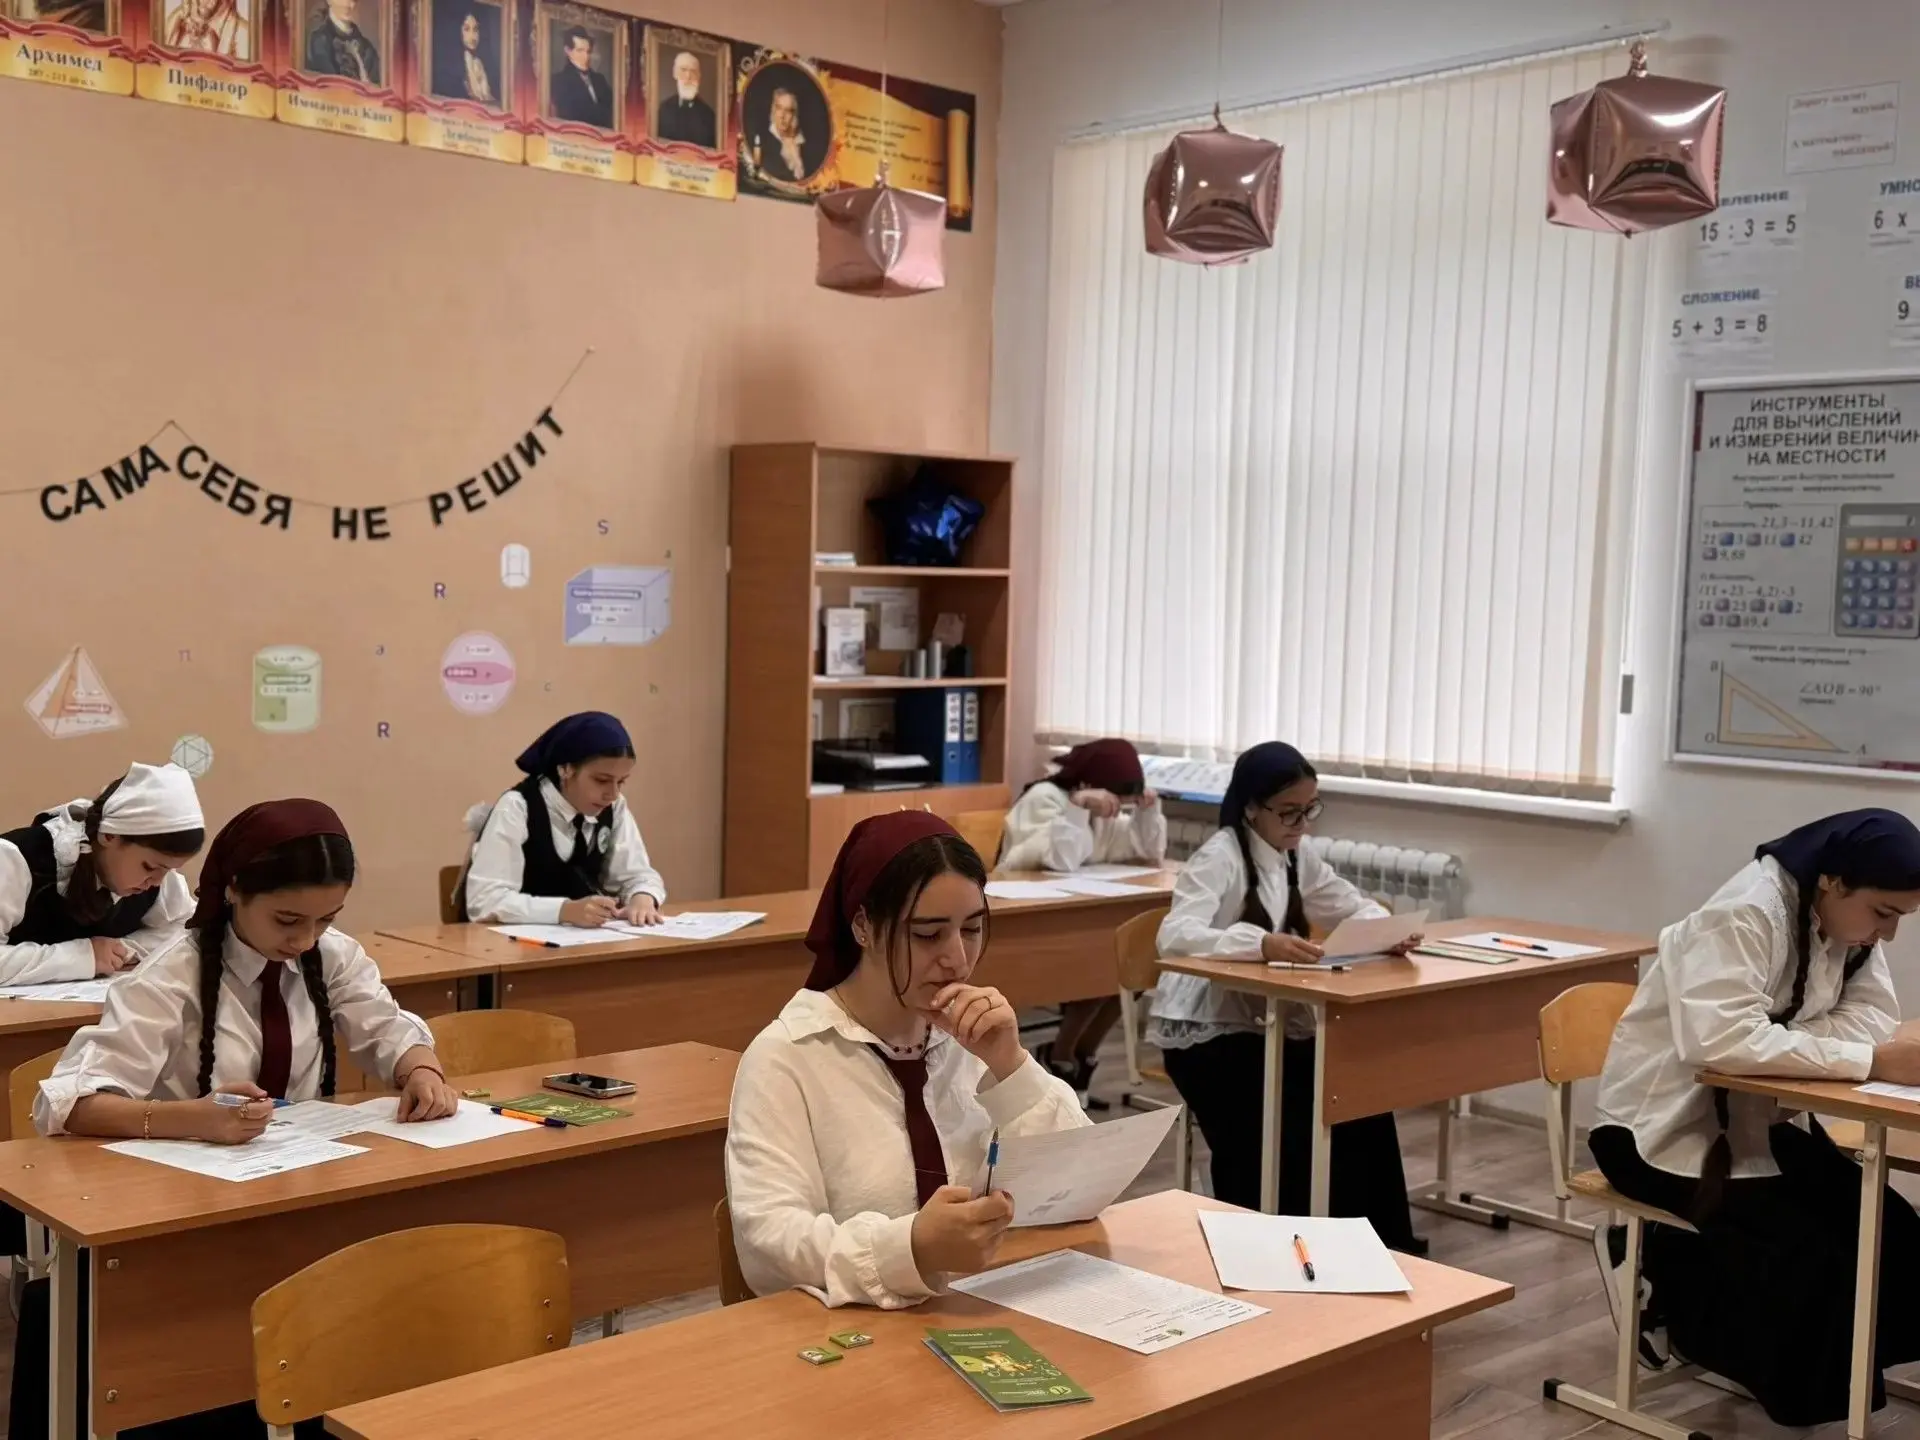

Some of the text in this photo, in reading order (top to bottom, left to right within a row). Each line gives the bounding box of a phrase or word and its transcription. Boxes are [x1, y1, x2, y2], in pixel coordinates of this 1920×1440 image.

[16, 44, 103, 72] Архимед
[168, 68, 248, 100] Пифагор
[1721, 190, 1790, 208] ЕЛЕНИЕ
[1700, 221, 1719, 242] 15
[1744, 218, 1755, 238] 3
[1765, 220, 1776, 231] =
[1786, 214, 1797, 234] 5
[1874, 210, 1884, 230] 6
[1681, 288, 1761, 306] СЛОЖЕНИЕ
[1898, 300, 1909, 320] 9
[1672, 313, 1768, 338] 5 + 3 = 8
[1750, 393, 1886, 412] ИНСТРУМЕНТЫ
[1732, 407, 1902, 433] ДЛЯ ВЫЧИСЛЕНИЙ
[1709, 435, 1720, 449] И
[1725, 429, 1832, 449] ИЗМЕРЕНИЙ
[1746, 448, 1887, 466] НА МЕСТНОСТИ
[40, 406, 564, 541] САМА СЕБЯ НЕ РЕШИТ
[597, 519, 609, 535] S
[434, 582, 447, 600] R
[377, 721, 390, 738] R
